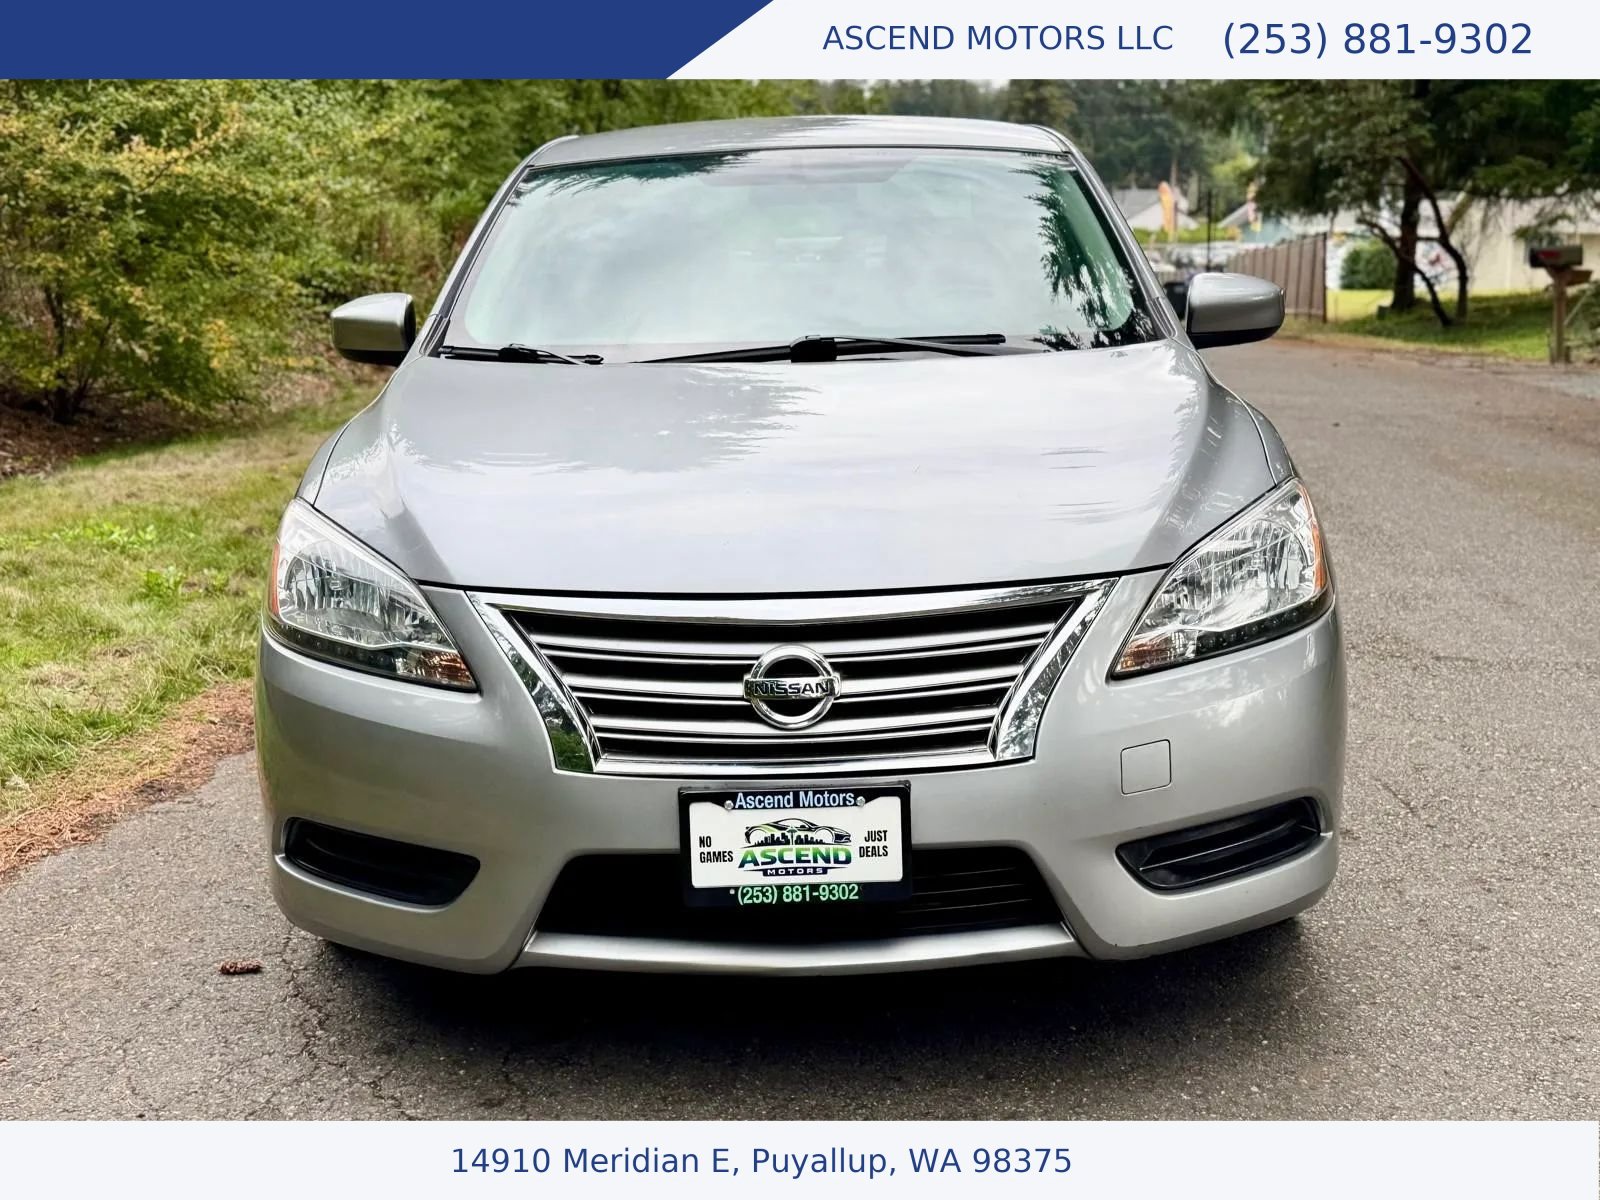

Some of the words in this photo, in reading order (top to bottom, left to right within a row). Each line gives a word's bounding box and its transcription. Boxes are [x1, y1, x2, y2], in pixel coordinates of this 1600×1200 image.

[753, 681, 831, 696] NISSAN
[735, 792, 794, 809] Ascend
[799, 790, 855, 807] Motors
[698, 835, 712, 848] NO
[864, 829, 888, 842] JUST
[699, 850, 734, 863] GAMES
[738, 847, 852, 869] ASCEND
[859, 845, 889, 858] DEALS
[767, 867, 824, 876] MOTORS
[737, 885, 778, 905] (253)
[782, 883, 859, 902] 881-9302
